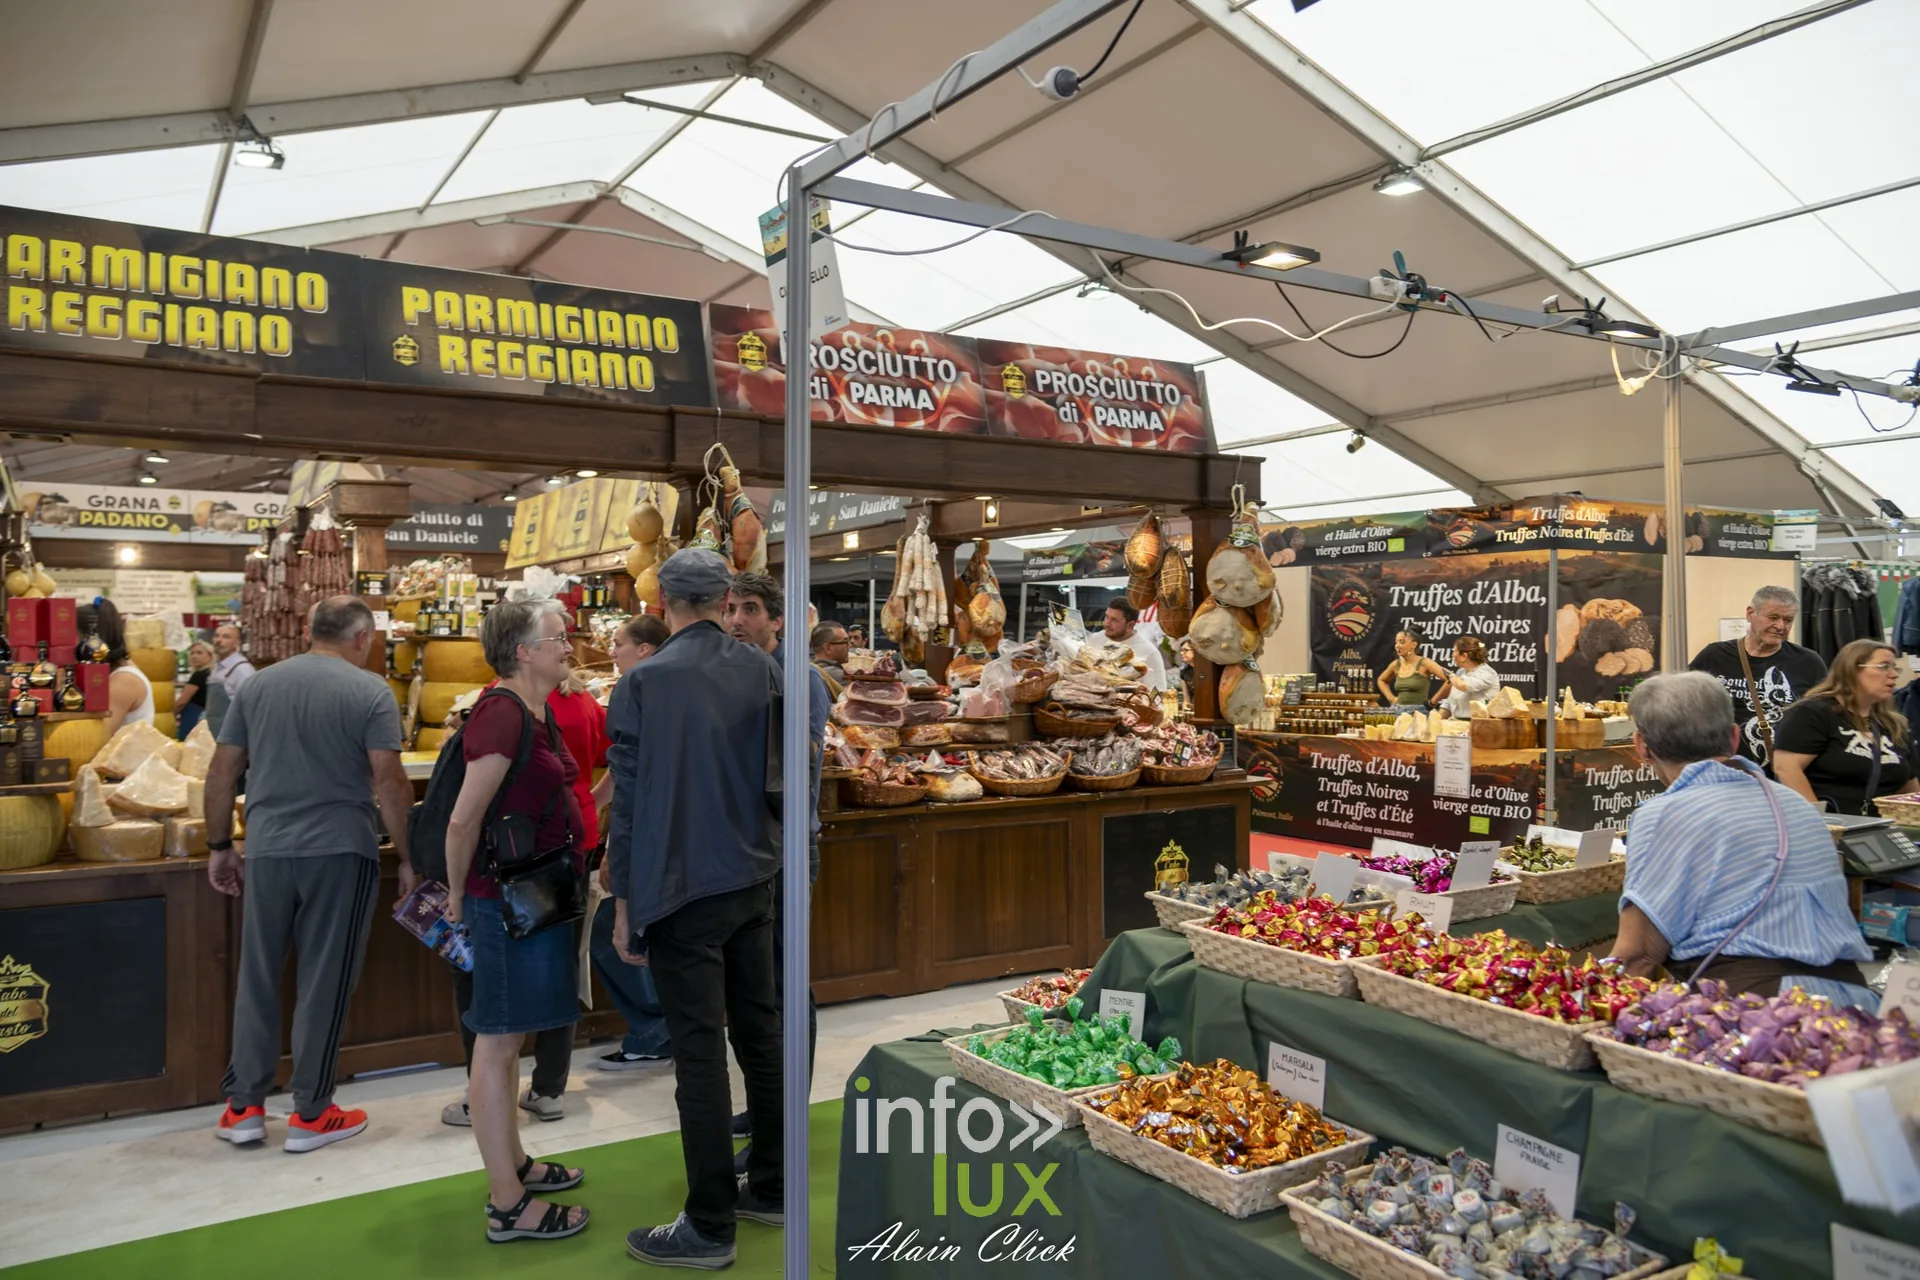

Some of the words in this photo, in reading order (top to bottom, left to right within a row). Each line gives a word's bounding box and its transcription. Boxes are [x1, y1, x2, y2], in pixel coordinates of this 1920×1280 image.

[0, 233, 328, 314] ARMIGIANO
[8, 285, 293, 357] REGGIANO
[401, 285, 680, 354] PARMIGIANO
[438, 334, 655, 393] REGGIANO
[810, 344, 958, 384] ROSCIUTTO
[849, 381, 936, 412] PARMA
[1034, 369, 1181, 407] PROSCIUTTO
[1058, 402, 1079, 425] di
[1093, 406, 1165, 432] PARMA
[86, 493, 162, 513] GRANA
[838, 503, 858, 521] San
[859, 495, 900, 517] Daniele
[1532, 504, 1574, 524] Truffes
[1575, 505, 1609, 525] d'Alba,
[78, 509, 169, 529] PADANO
[466, 513, 484, 527] di
[415, 530, 480, 545] Daniele
[1325, 532, 1334, 541] et
[1335, 529, 1360, 541] Huile
[1361, 526, 1394, 539] d'Olive
[1494, 527, 1538, 545] Truffes
[1538, 525, 1574, 539] Noires
[1574, 528, 1583, 536] et
[1584, 526, 1613, 544] Truffes
[1315, 545, 1341, 558] vierge
[1341, 543, 1366, 556] extra
[1366, 541, 1387, 553] BIO
[1389, 584, 1464, 611] Truffes
[1468, 580, 1547, 606] d'Alba,
[1400, 615, 1463, 640] Truffes
[1465, 615, 1532, 635] Noires
[1340, 650, 1362, 660] Alba,
[1487, 639, 1537, 663] d'Été
[1310, 752, 1363, 776] Truffes
[1365, 758, 1421, 782] d'Alba,
[1584, 764, 1634, 790] Truffes
[1317, 777, 1363, 798] Truffes
[1364, 782, 1409, 801] Noires
[1484, 785, 1529, 803] d'Olive
[1316, 799, 1328, 812] et
[1331, 800, 1377, 820] Truffes
[1379, 803, 1414, 823] d'Été
[1432, 798, 1469, 816] vierge
[1470, 804, 1501, 817] extra
[1502, 804, 1532, 819] BIO
[1592, 791, 1633, 814] Truffes
[1364, 825, 1373, 833] ou
[1383, 828, 1414, 839] saumure
[1281, 1052, 1315, 1072] MARSALA
[1505, 1131, 1565, 1164] CHAMPAGNE
[1520, 1151, 1552, 1171] FRAISE
